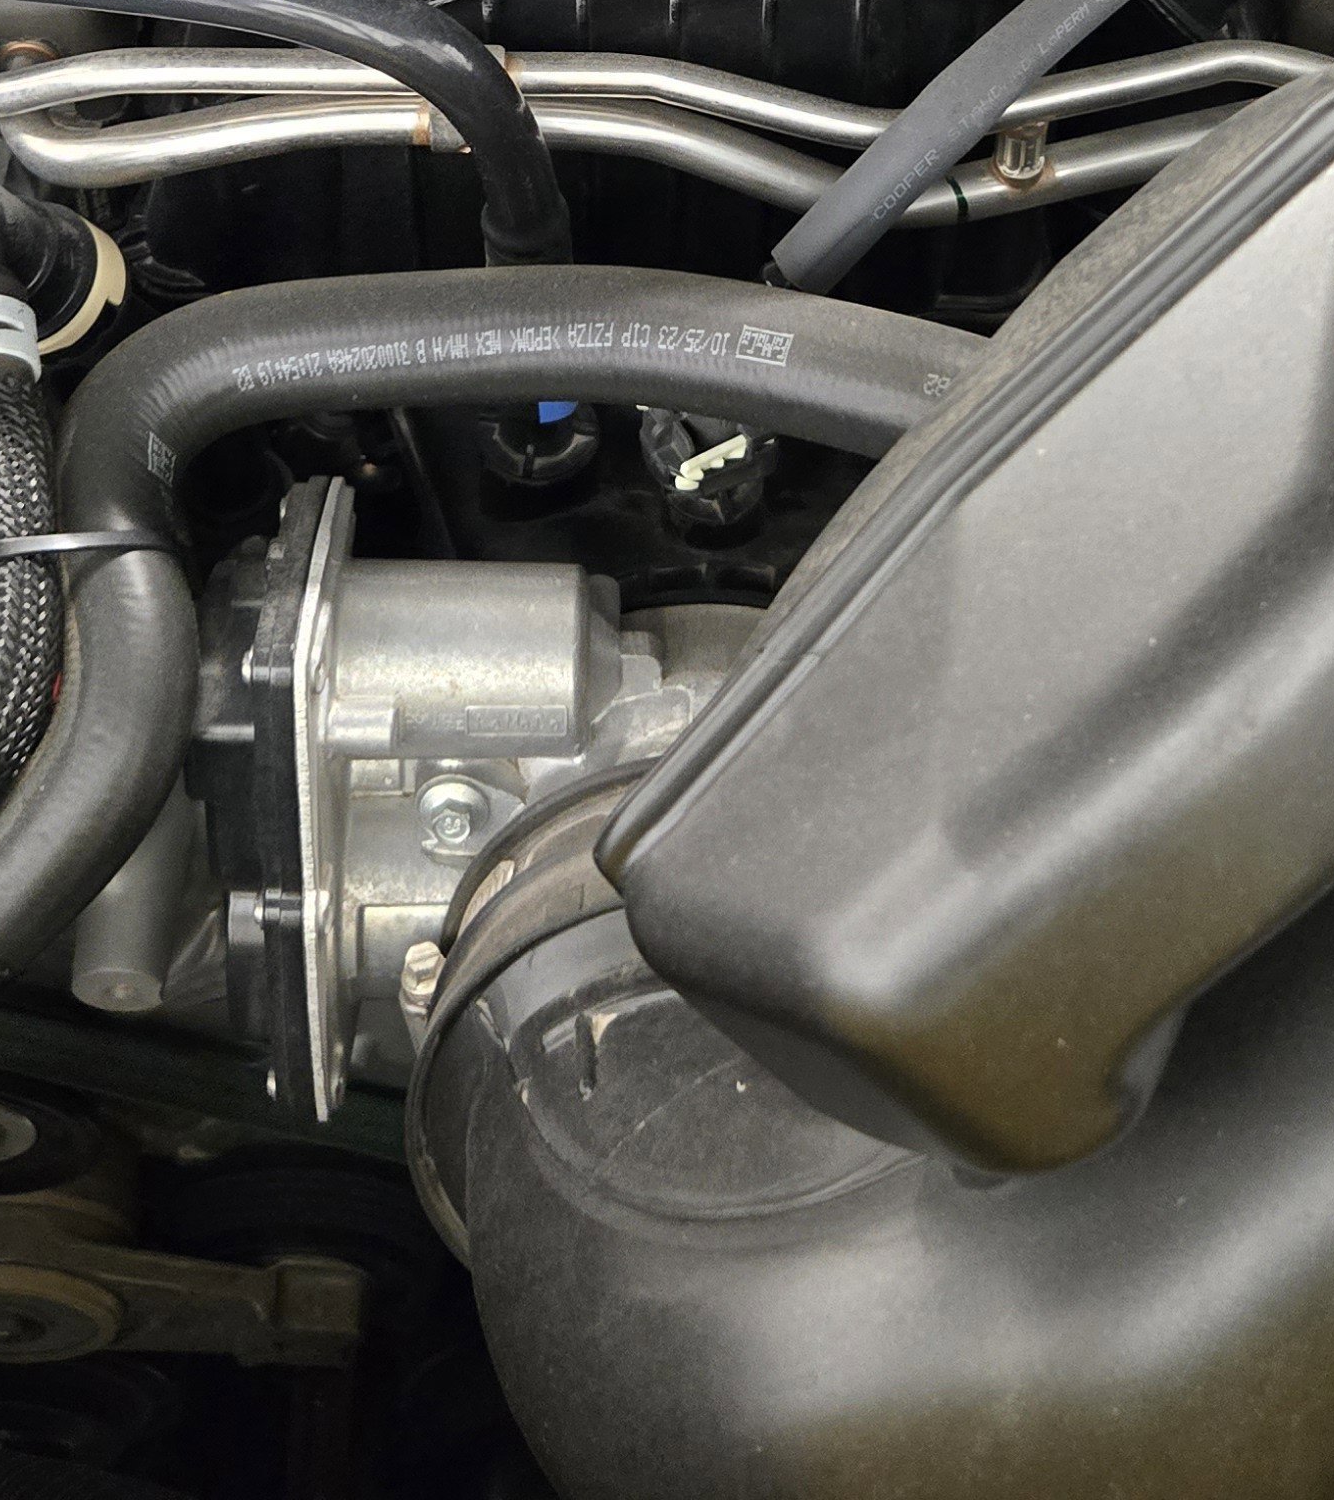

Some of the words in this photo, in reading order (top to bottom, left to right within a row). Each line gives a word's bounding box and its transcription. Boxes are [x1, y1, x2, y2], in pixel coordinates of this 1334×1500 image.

[873, 148, 942, 222] COOPER
[475, 328, 502, 356] MEX
[620, 322, 651, 349] CIP
[657, 325, 731, 357] 10/25/23
[415, 338, 426, 364] B
[255, 350, 322, 386] 21:54:19
